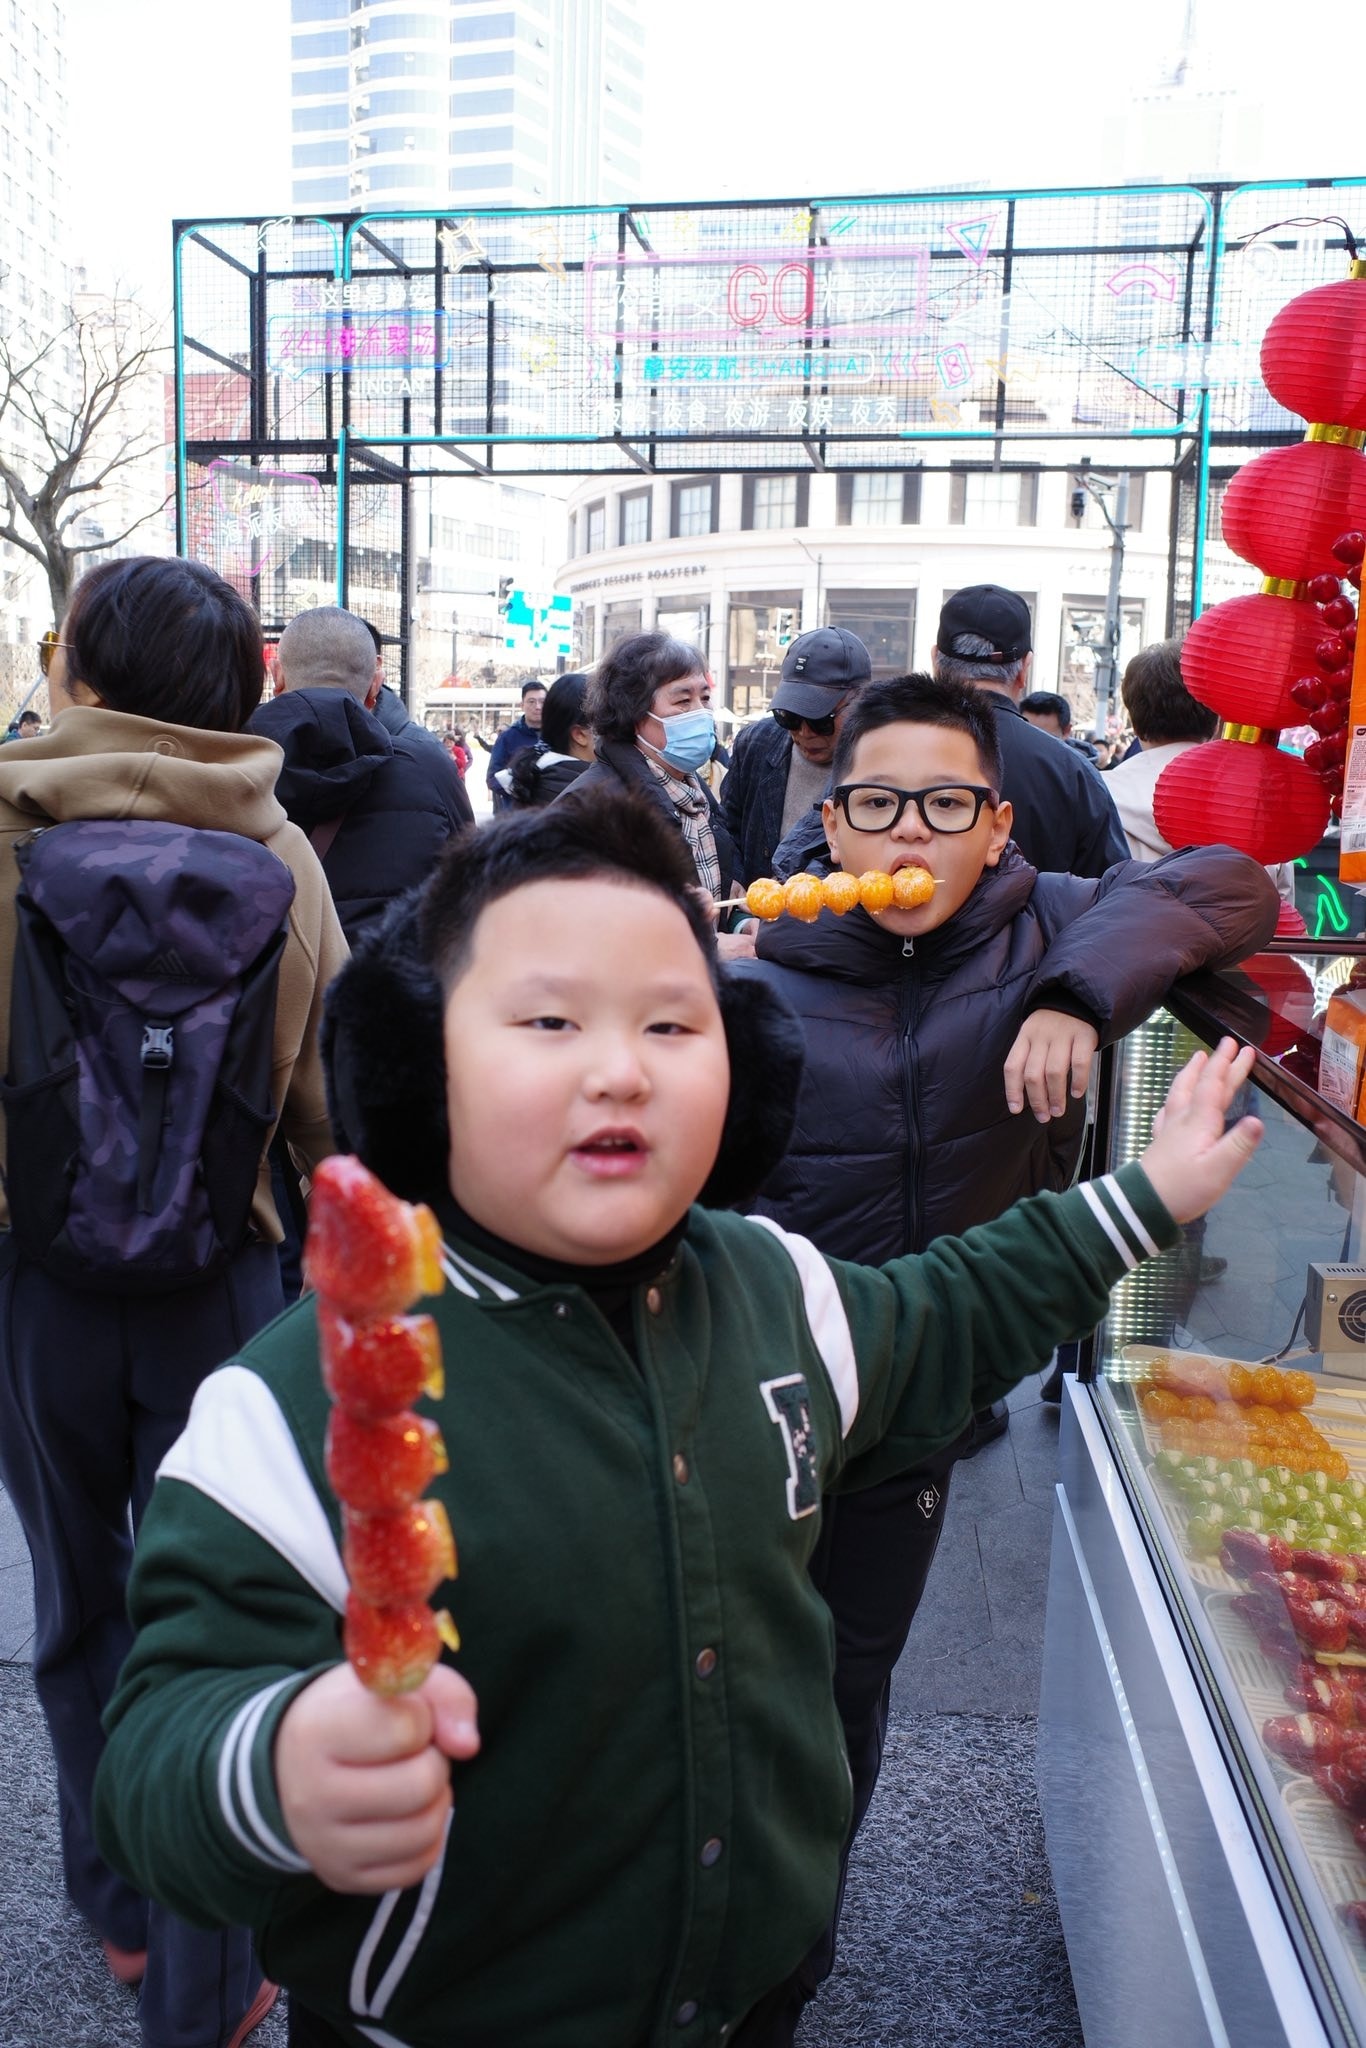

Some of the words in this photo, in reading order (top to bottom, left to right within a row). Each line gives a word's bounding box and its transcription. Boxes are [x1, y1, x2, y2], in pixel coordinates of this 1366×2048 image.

[749, 356, 866, 378] SHANGHAI
[399, 378, 426, 395] AN
[648, 565, 707, 581] ROASTERY
